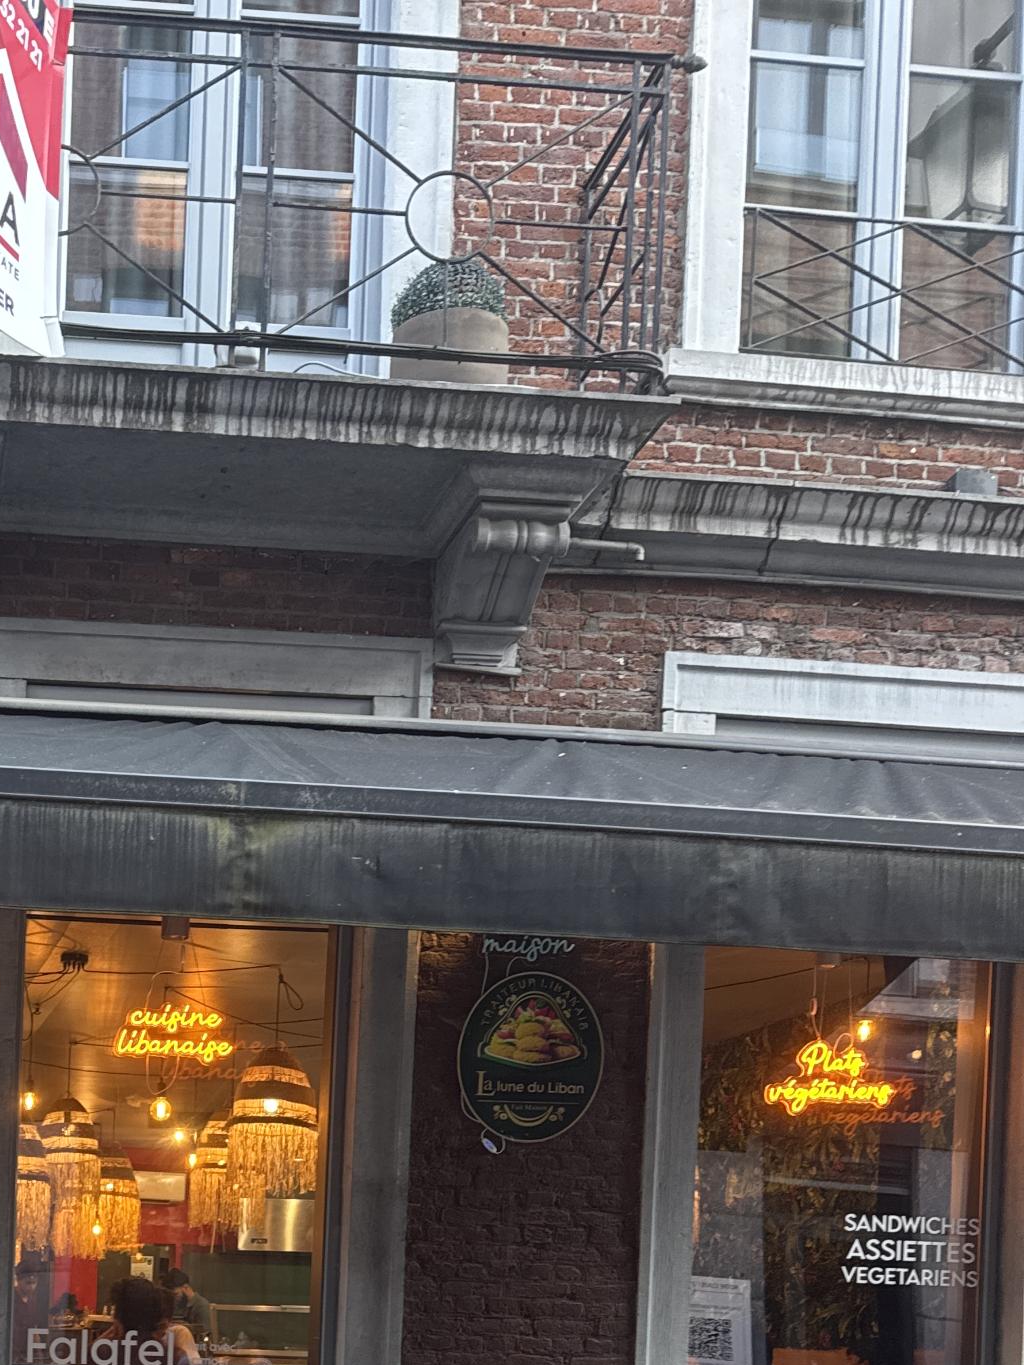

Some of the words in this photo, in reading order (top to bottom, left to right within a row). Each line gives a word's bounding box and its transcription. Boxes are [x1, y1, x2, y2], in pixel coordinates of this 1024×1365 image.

[482, 935, 575, 962] maison
[130, 1004, 223, 1033] cuisine
[117, 1029, 233, 1063] libanaise
[802, 1043, 866, 1077] Plats
[475, 1070, 496, 1096] La
[497, 1081, 525, 1093] lune
[527, 1081, 545, 1093] du
[548, 1082, 585, 1094] Liban
[769, 1080, 894, 1113] végétariens
[844, 1213, 980, 1236] SANDWICHES
[846, 1238, 975, 1263] ASSIETTES
[841, 1265, 978, 1288] VEGETARIENS
